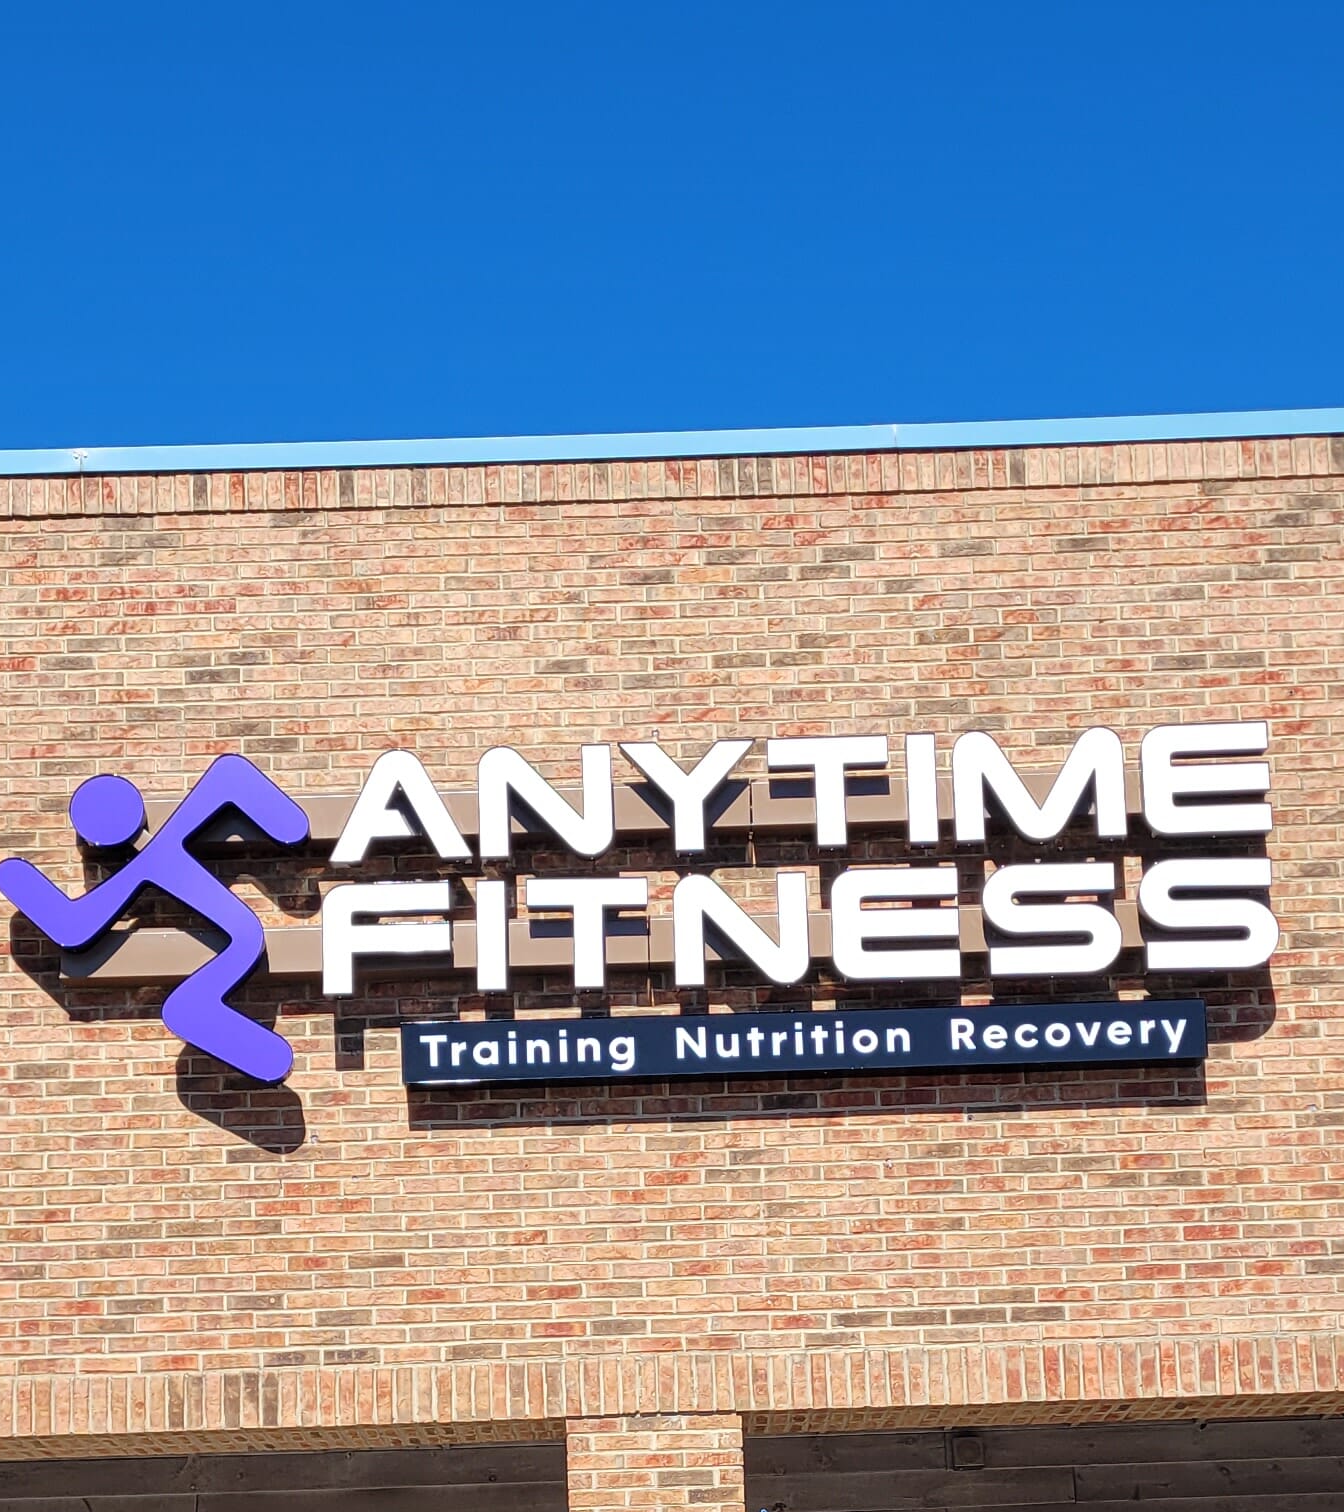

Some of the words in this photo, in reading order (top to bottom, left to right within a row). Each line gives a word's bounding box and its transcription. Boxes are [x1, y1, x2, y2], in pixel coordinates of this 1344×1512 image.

[330, 722, 1273, 862] ANYTIME
[322, 858, 1279, 994] FITNESS
[419, 1031, 635, 1072] Training
[676, 1024, 911, 1059] Nutrition
[950, 1018, 1187, 1053] Recovery
